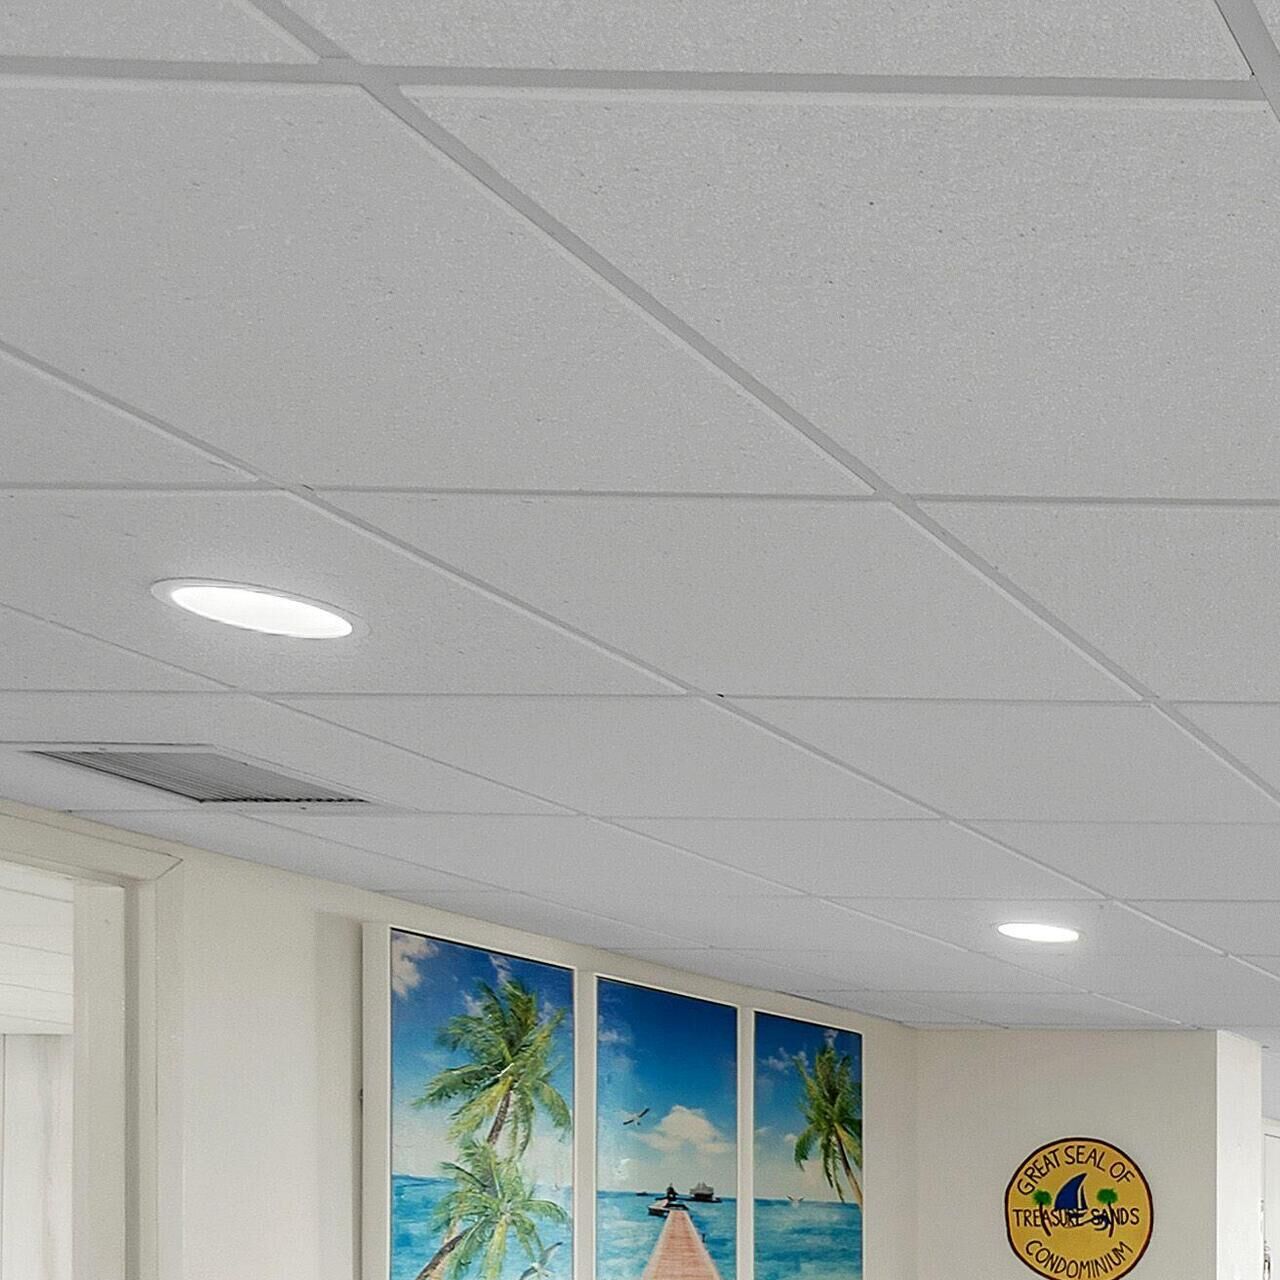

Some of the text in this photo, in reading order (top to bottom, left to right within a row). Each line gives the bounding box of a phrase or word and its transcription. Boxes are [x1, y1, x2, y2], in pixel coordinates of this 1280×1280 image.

[1017, 1145, 1135, 1196] GREAT SEAL OF
[1091, 1208, 1139, 1226] SANDS
[1026, 1240, 1133, 1280] CONDOMINIUM
